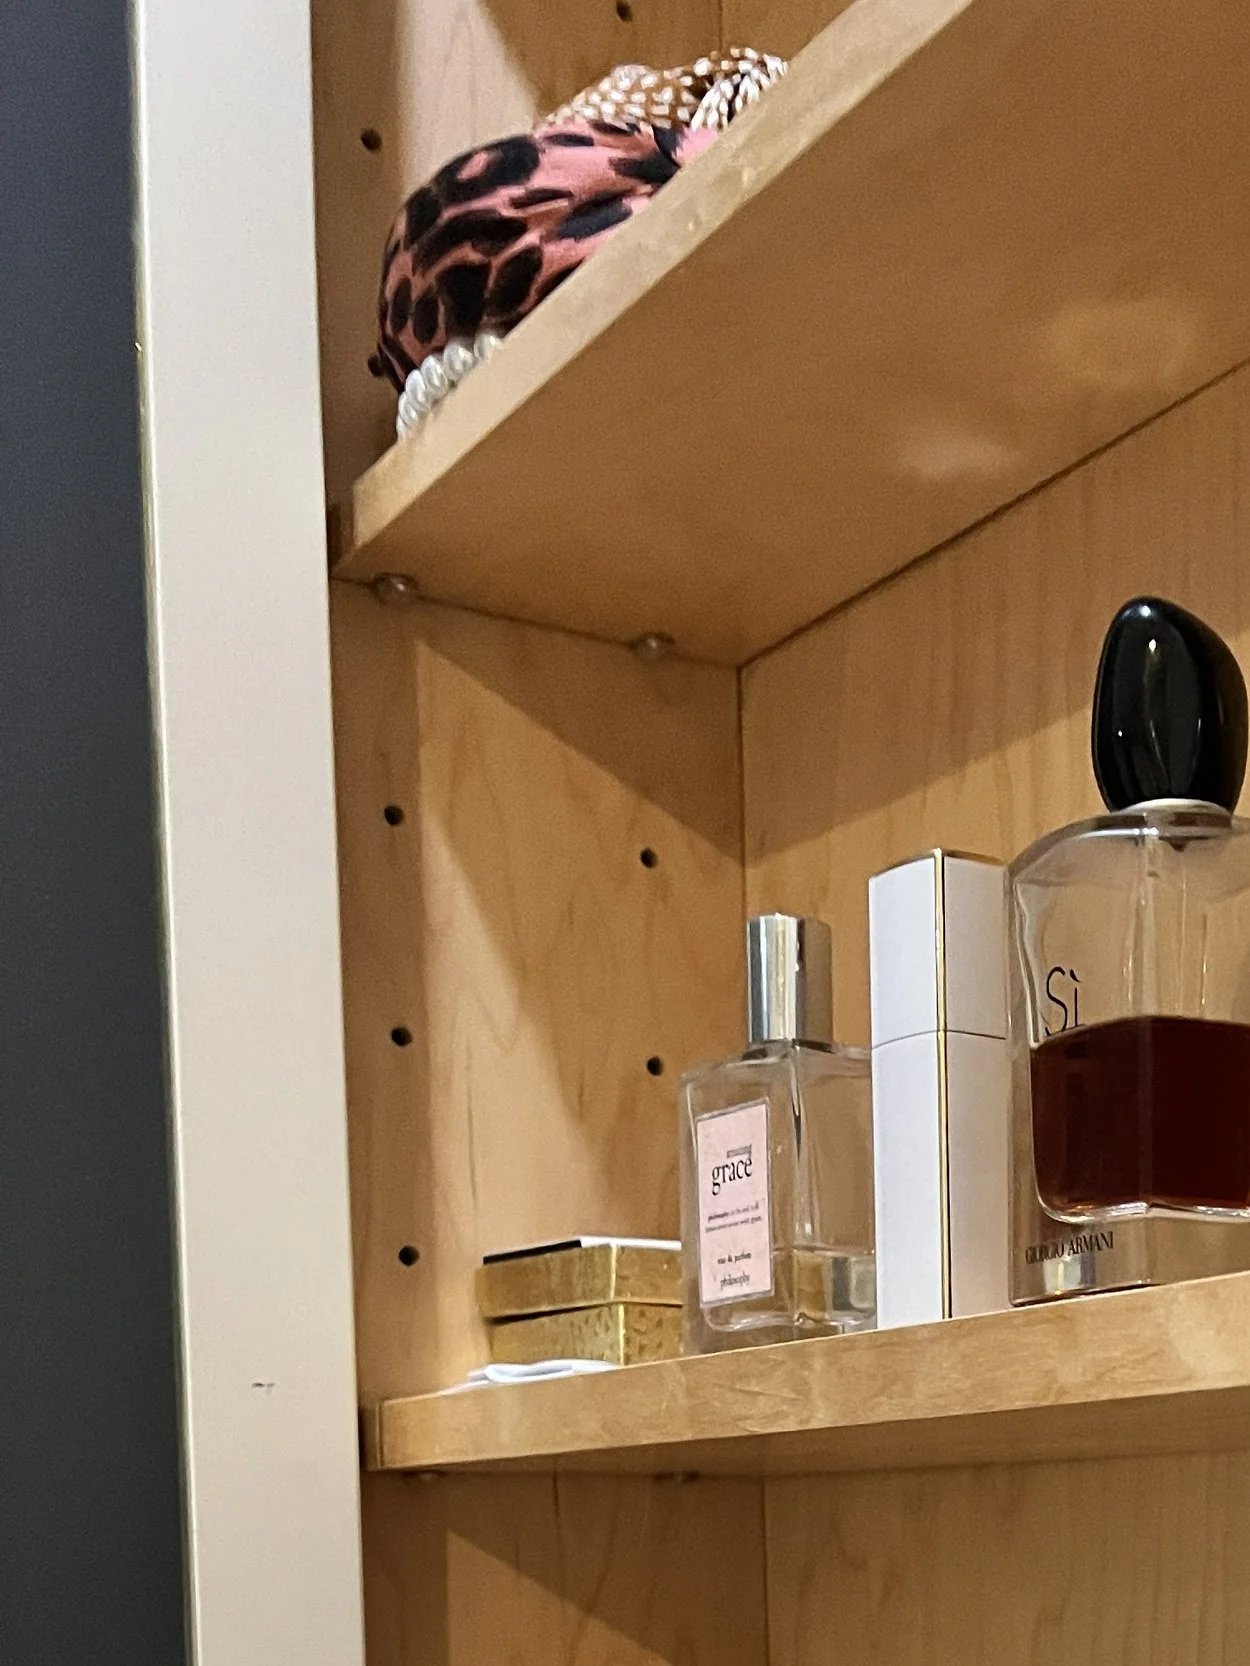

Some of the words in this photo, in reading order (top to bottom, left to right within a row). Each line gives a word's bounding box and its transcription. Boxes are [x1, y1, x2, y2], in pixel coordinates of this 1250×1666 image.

[711, 1156, 752, 1196] grace
[1025, 1237, 1065, 1265] GIORGIO
[1066, 1231, 1114, 1256] ARMANI
